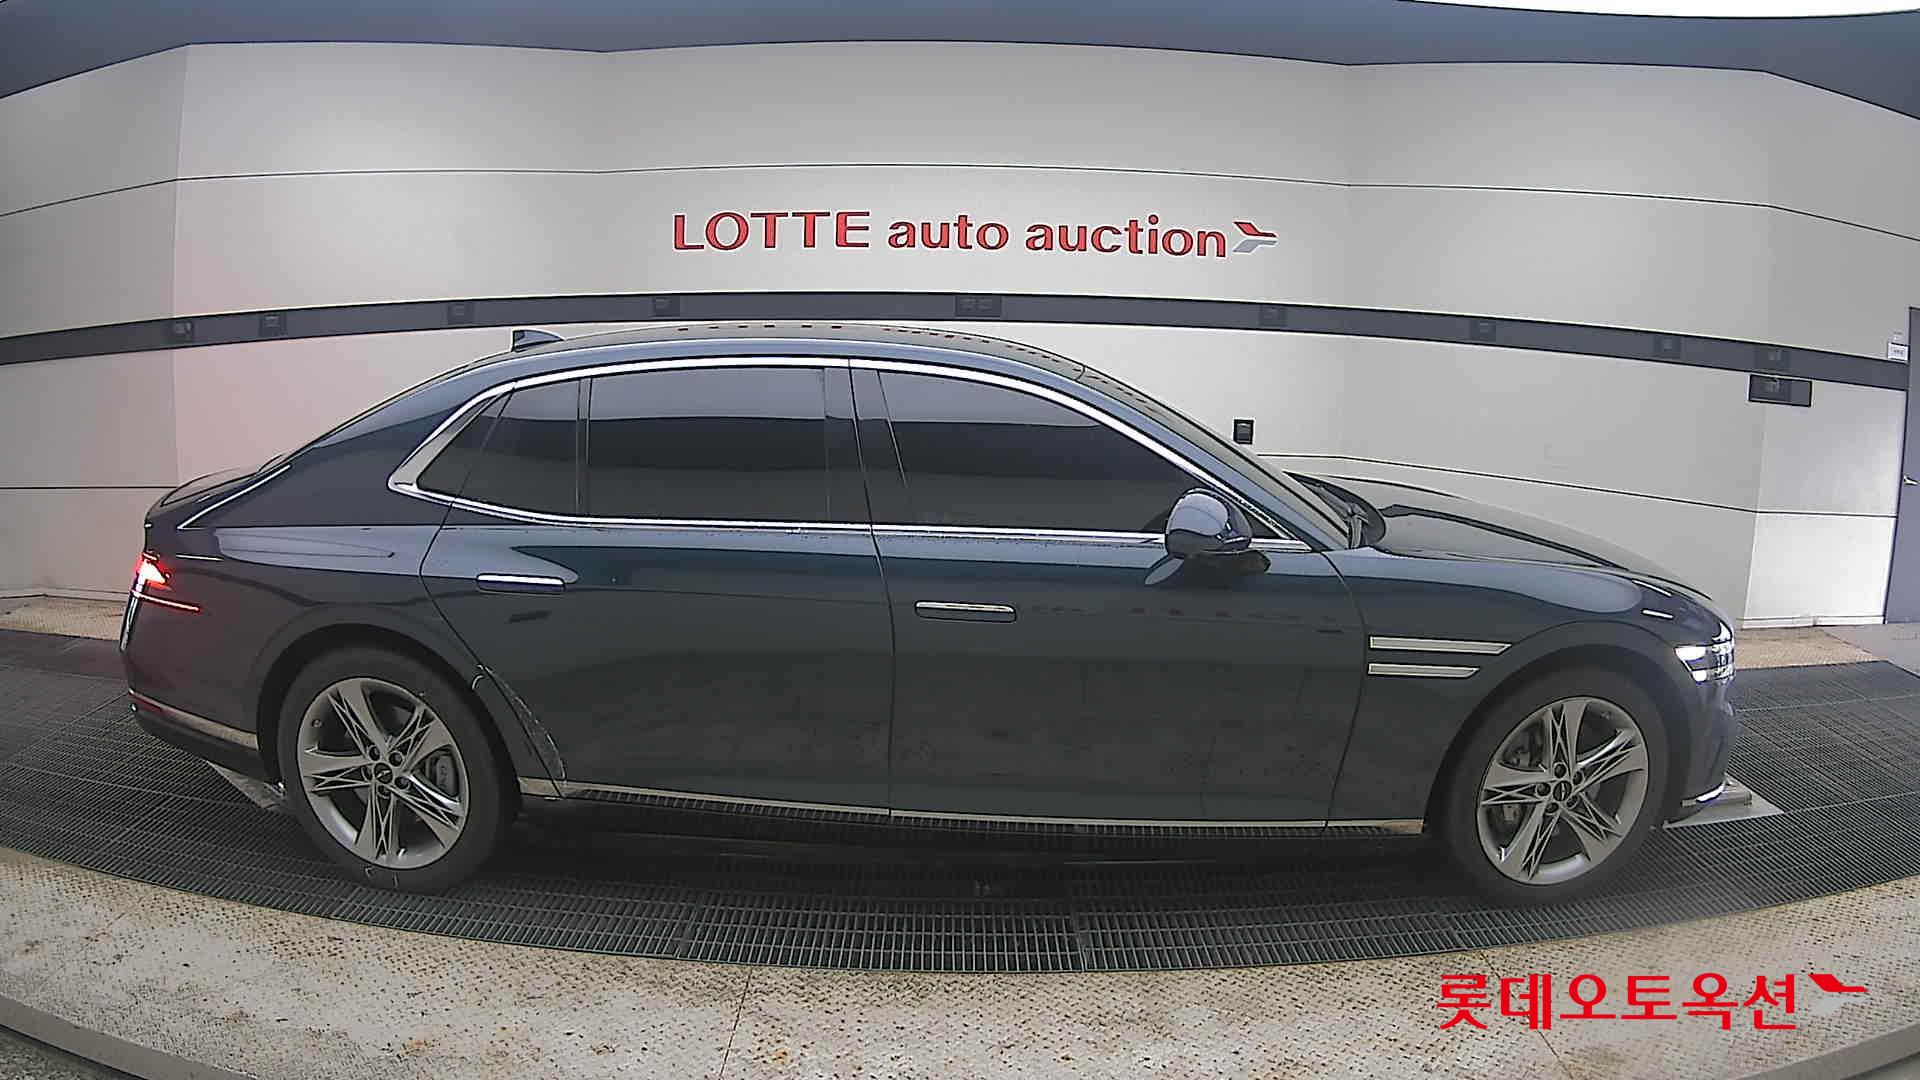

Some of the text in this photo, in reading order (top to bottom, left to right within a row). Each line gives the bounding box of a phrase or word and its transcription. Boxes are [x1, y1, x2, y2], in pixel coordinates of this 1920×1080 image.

[673, 211, 1227, 258] LOTTE auto auction
